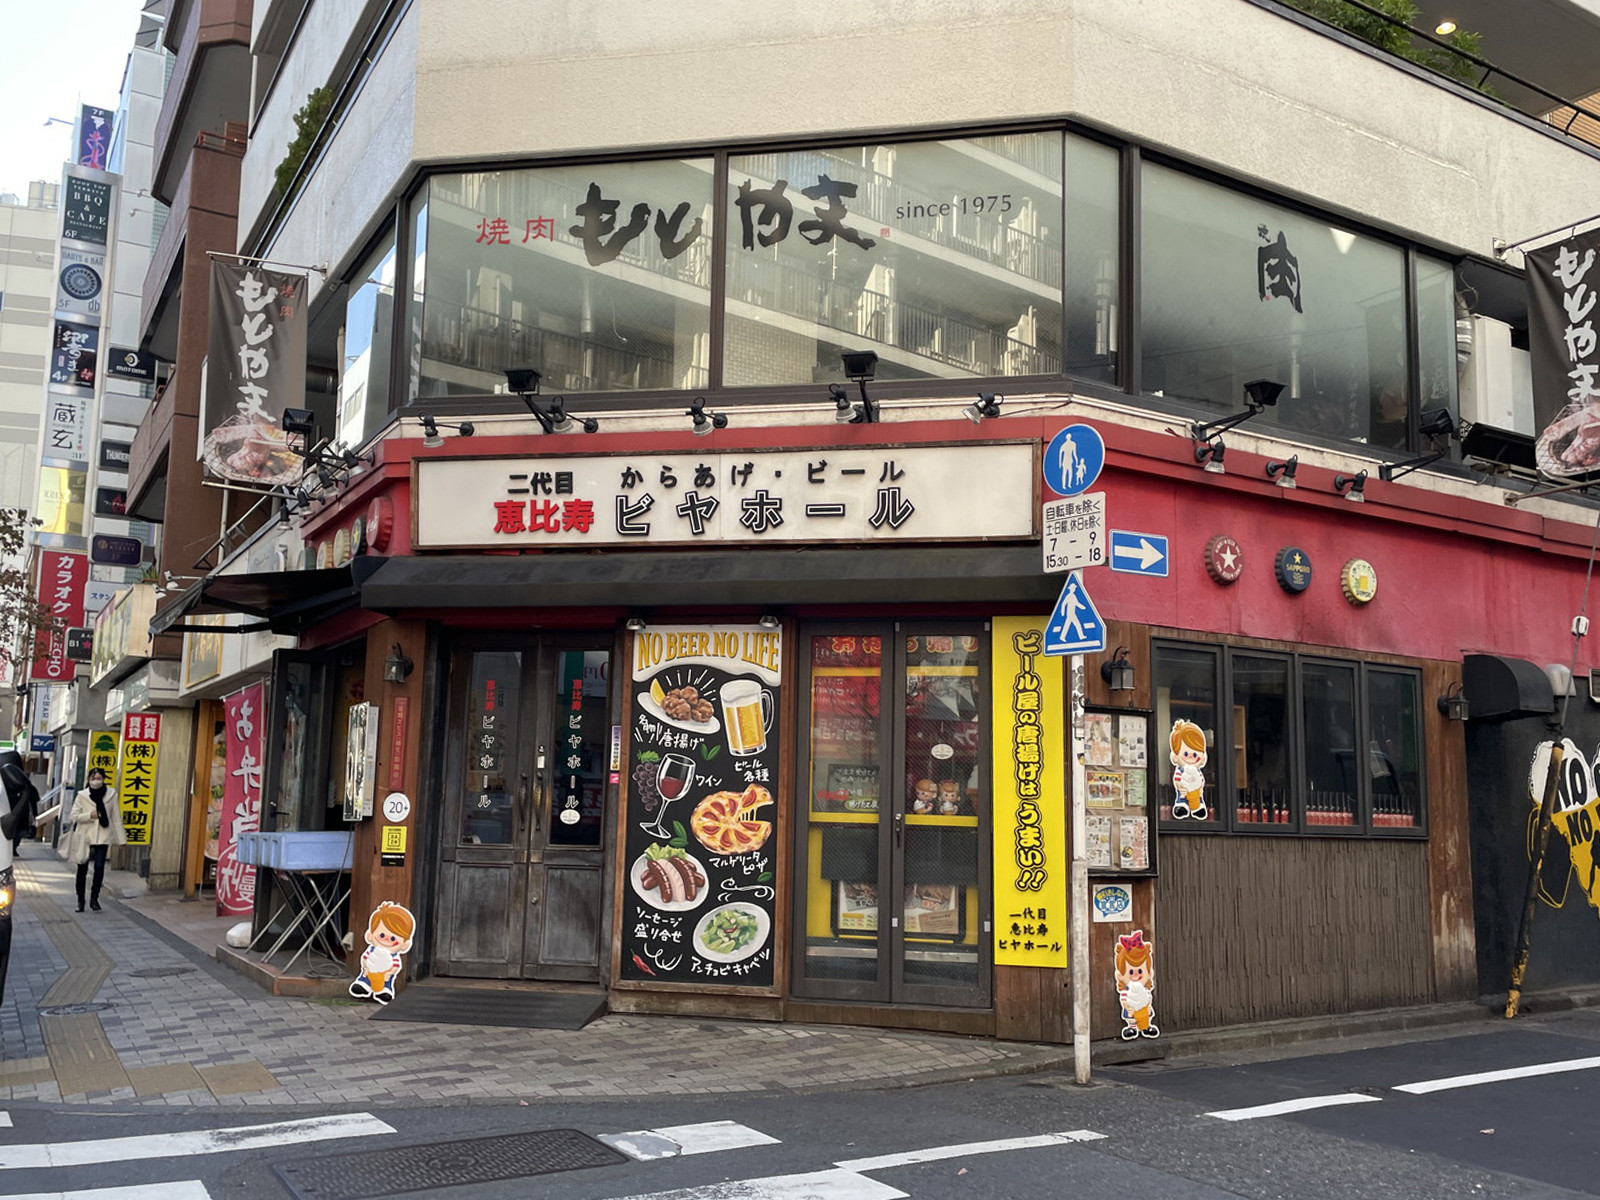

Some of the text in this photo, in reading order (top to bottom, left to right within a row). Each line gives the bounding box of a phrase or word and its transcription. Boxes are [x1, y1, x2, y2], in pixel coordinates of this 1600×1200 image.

[74, 192, 103, 206] BBQ
[83, 204, 91, 212] &
[896, 194, 1012, 219] since 1975
[67, 210, 107, 226] CAFE
[64, 229, 78, 239] 6F
[475, 215, 555, 246] 焼肉
[279, 284, 296, 320] 焼肉
[236, 271, 279, 423] もとやま
[52, 370, 68, 382] 4F
[51, 402, 77, 450] 蔵玄
[507, 471, 574, 496] 二代目
[493, 487, 915, 536] 恵比寿 ビヤホール
[1046, 500, 1101, 521] 自転車を除く
[1050, 538, 1057, 552] 7
[1090, 531, 1097, 545] 9
[1089, 547, 1101, 562] 18
[52, 555, 75, 614] カラオケ
[69, 639, 80, 648] B1
[637, 632, 663, 671] NO
[665, 631, 711, 662] BEER
[712, 632, 739, 658] NO
[741, 631, 780, 672] LIFE
[658, 728, 705, 751] 唐揚げ
[734, 759, 763, 772] ビール
[744, 768, 770, 783] 各種
[695, 774, 723, 787] ワイン
[1566, 808, 1594, 847] NO
[708, 851, 761, 869] マルゲリータ
[743, 858, 769, 875] ピザ
[635, 906, 683, 928] ソーセージ
[634, 922, 683, 944] 盛り合せ
